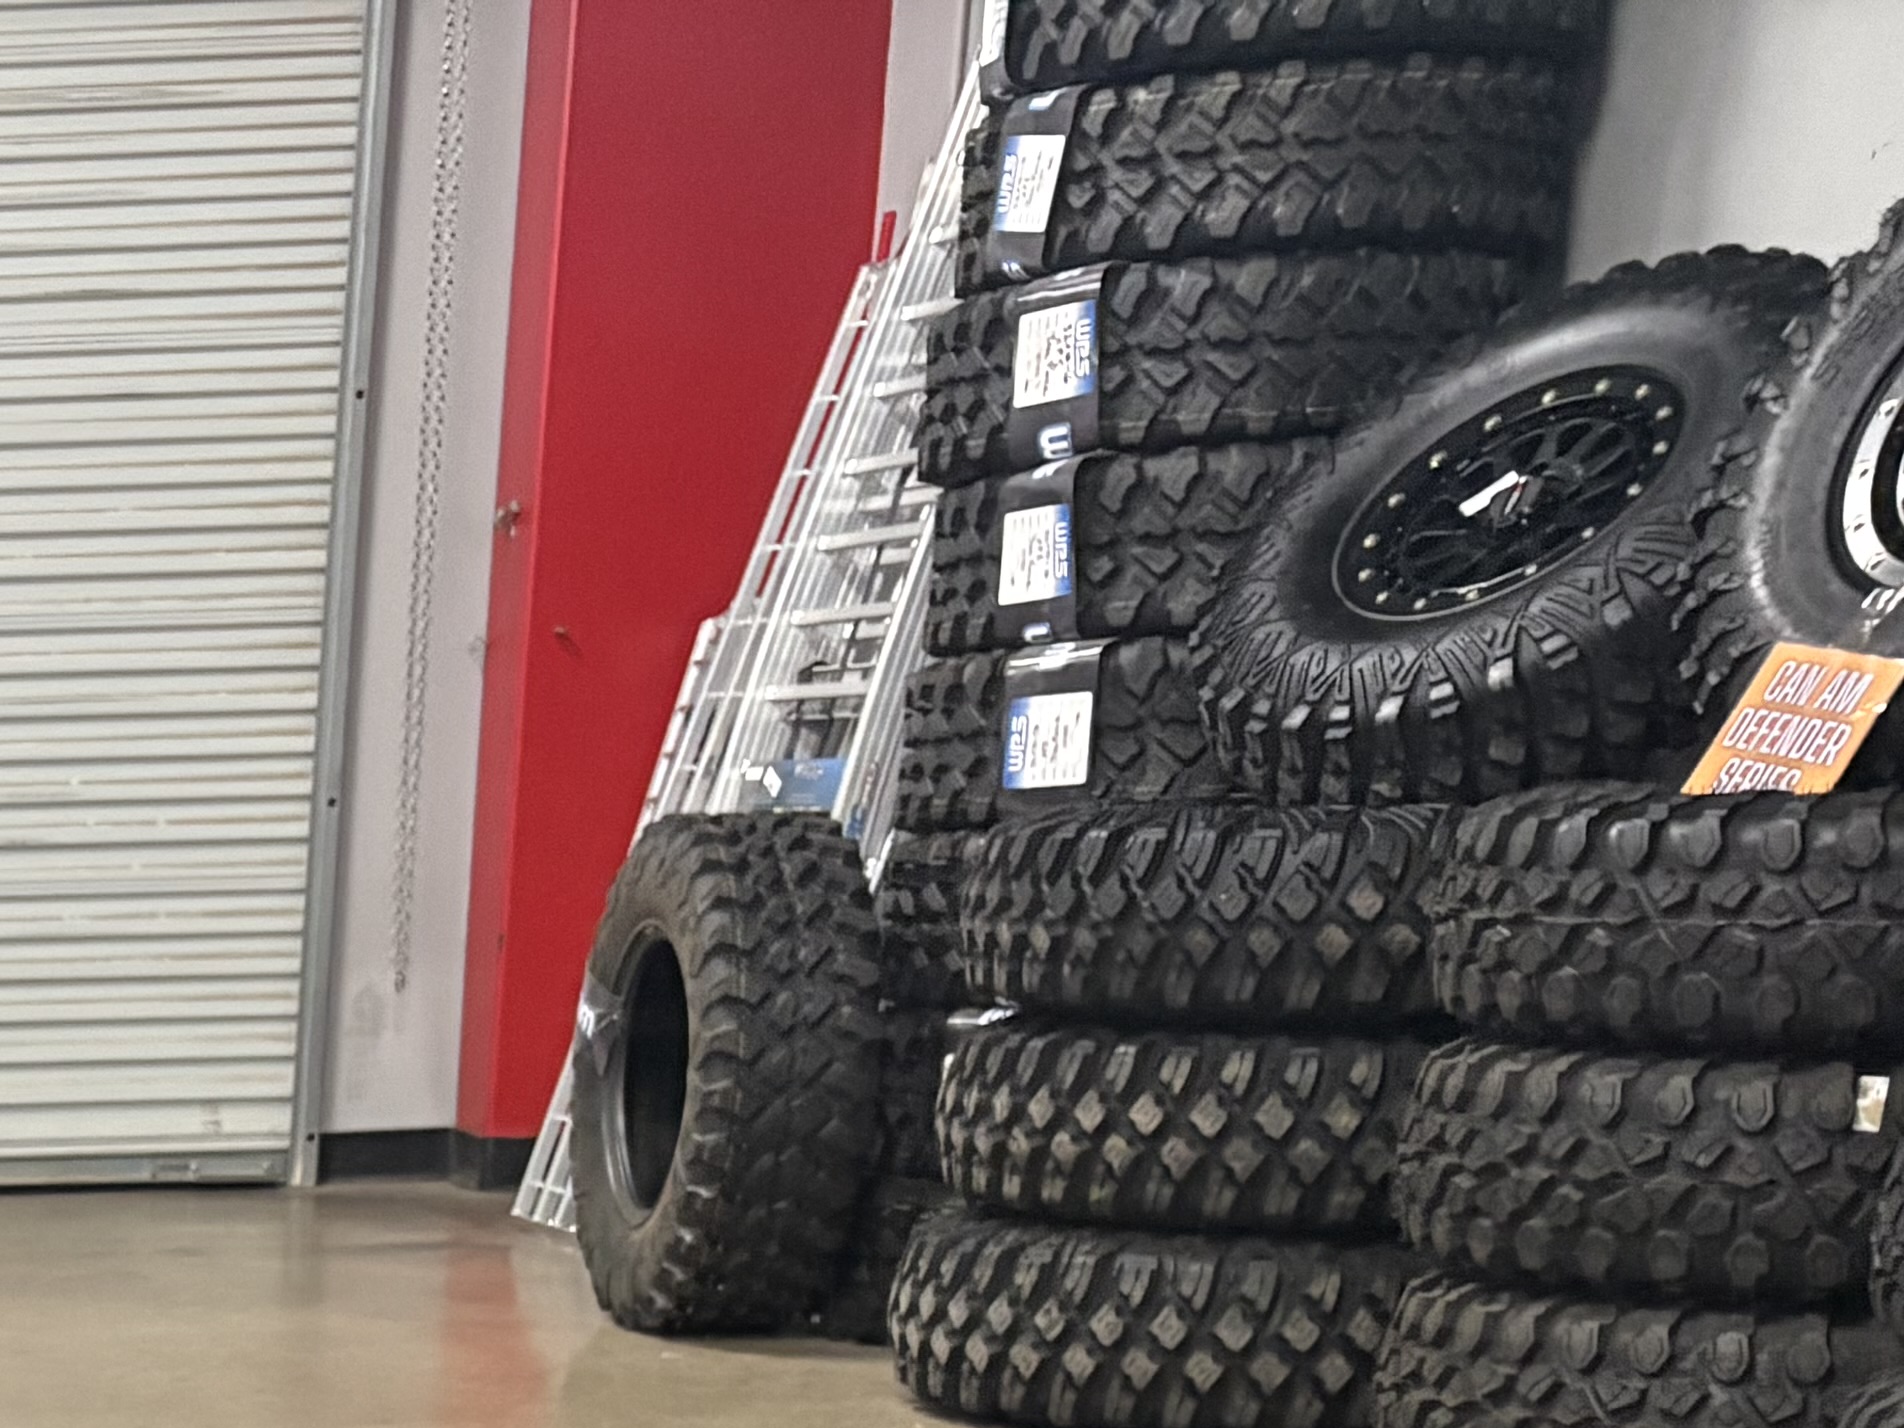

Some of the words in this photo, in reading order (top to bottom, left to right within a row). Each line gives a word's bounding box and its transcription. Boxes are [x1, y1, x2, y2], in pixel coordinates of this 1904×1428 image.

[997, 154, 1018, 214] WPS
[1075, 318, 1093, 378] WPS
[1053, 521, 1069, 579] WPS
[1763, 660, 1829, 707] CAN
[1813, 668, 1875, 715] AM
[1008, 714, 1029, 772] WPS
[1722, 707, 1853, 767] DEFENDER
